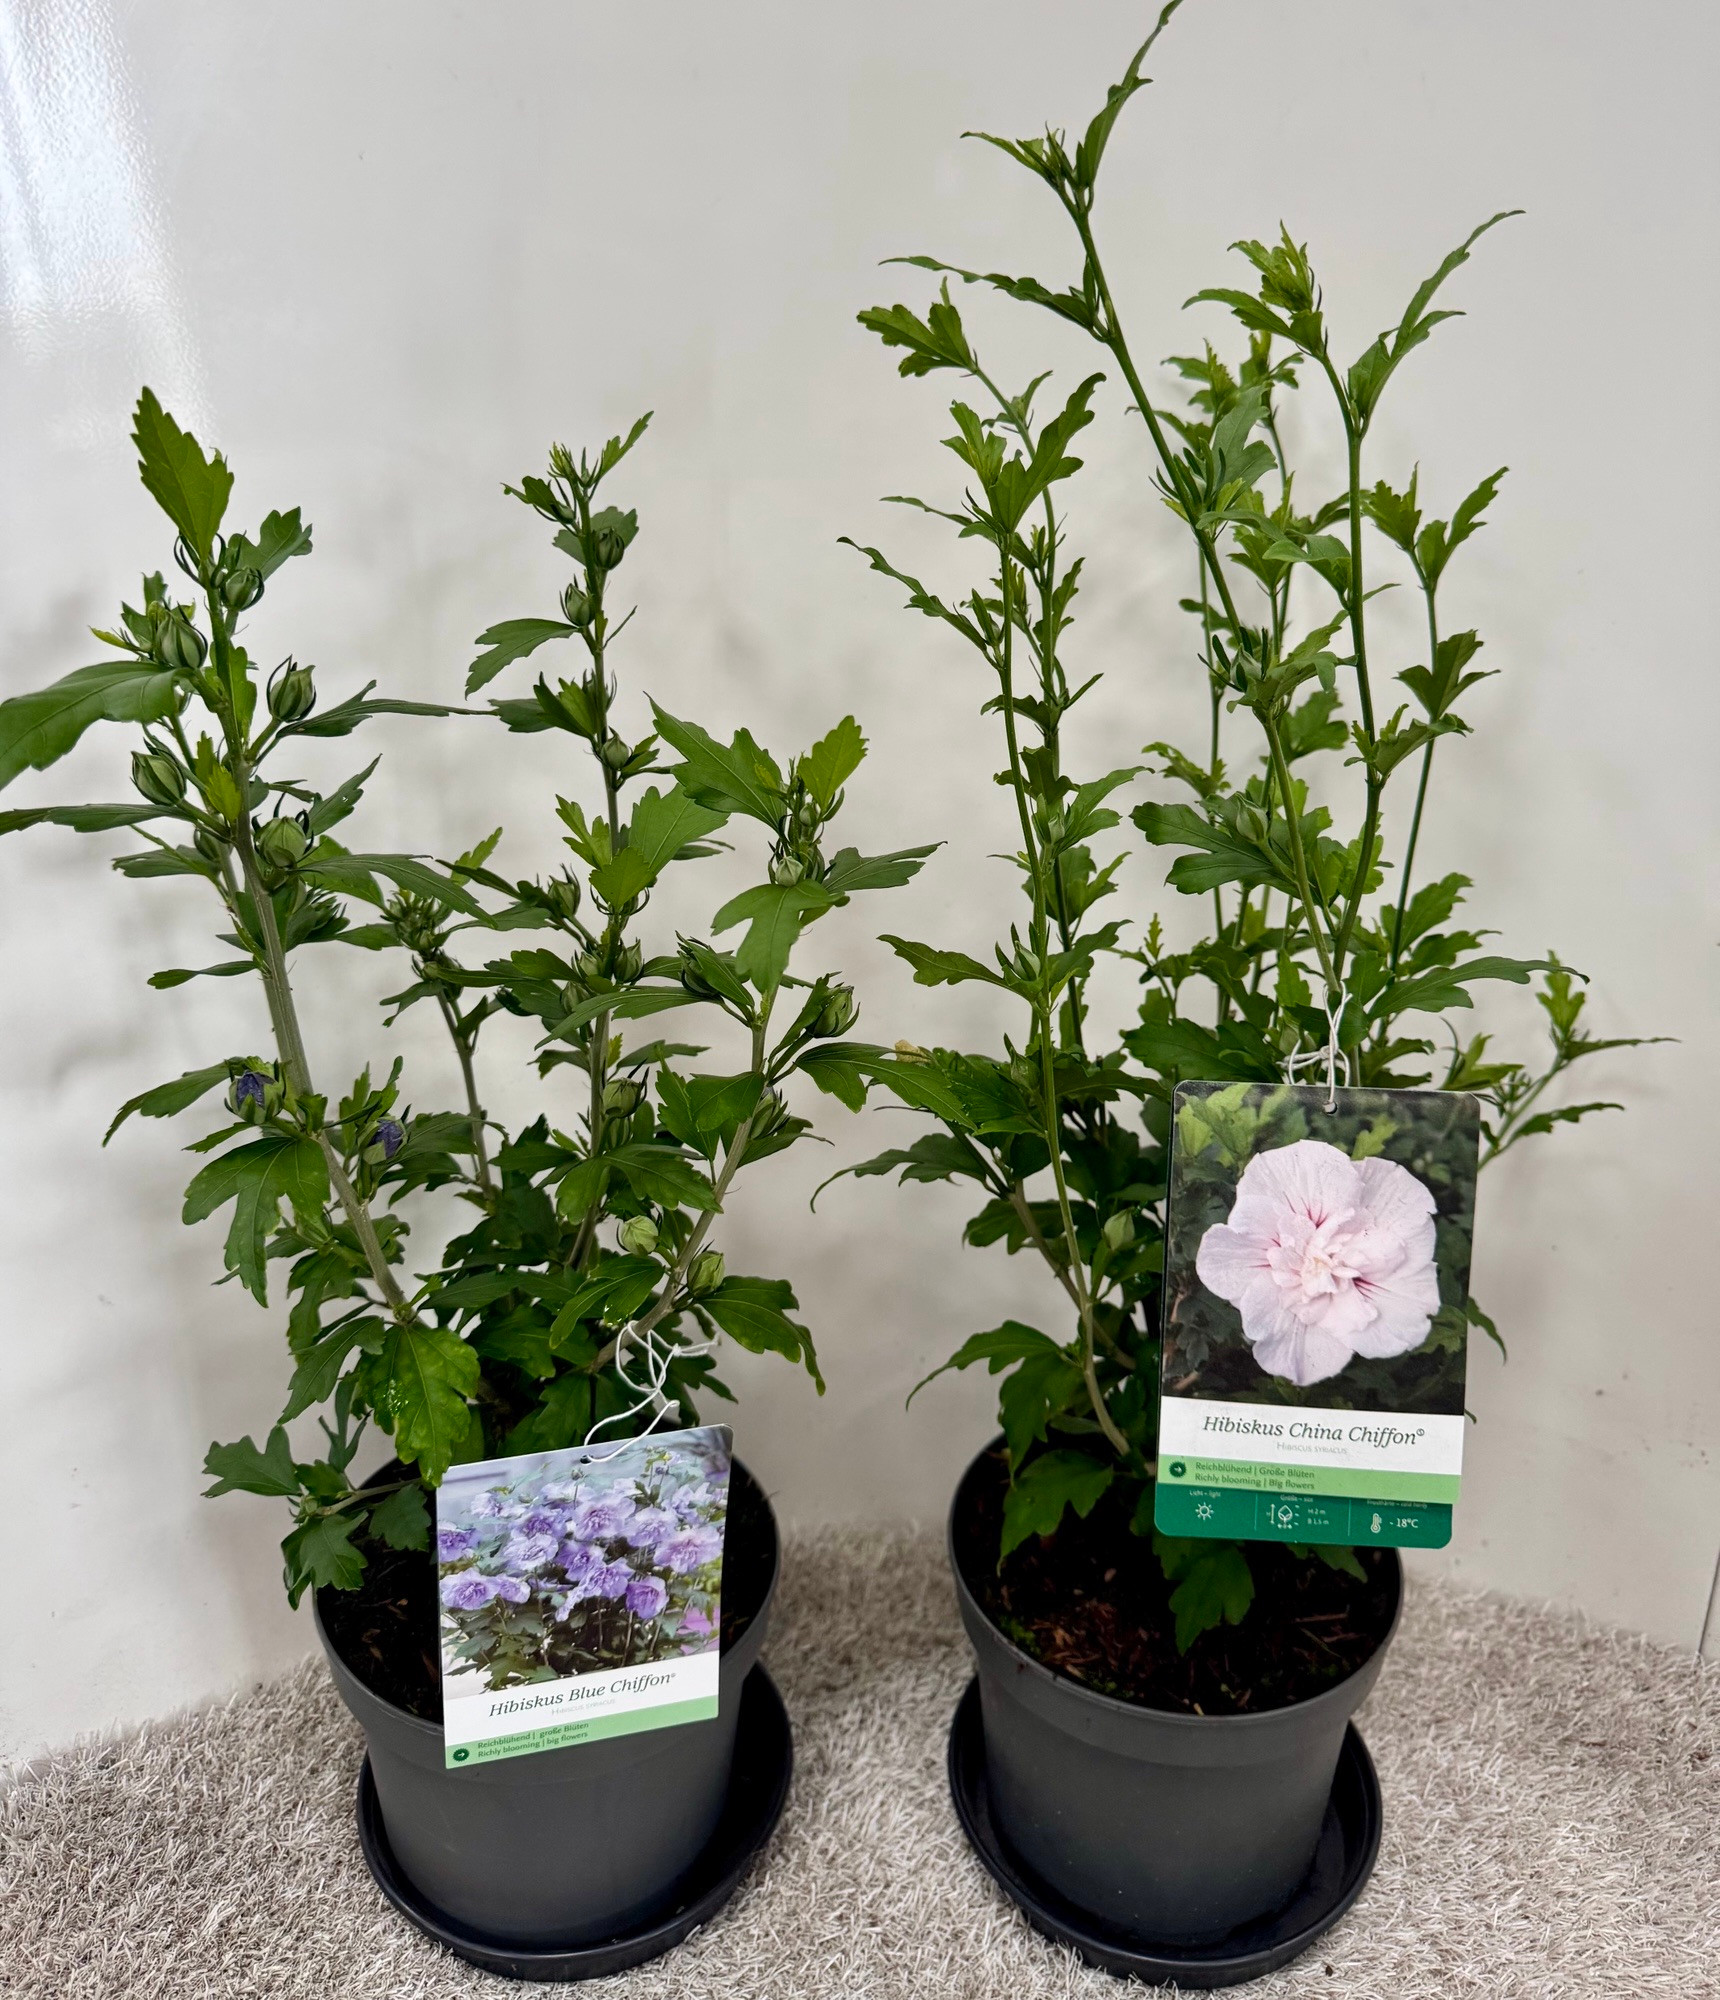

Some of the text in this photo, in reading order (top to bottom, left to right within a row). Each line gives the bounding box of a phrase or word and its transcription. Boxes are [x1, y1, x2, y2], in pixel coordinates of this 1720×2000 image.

[1203, 1416, 1284, 1437] Hibiskus
[1289, 1422, 1343, 1441] China
[1195, 1461, 1252, 1474] Reichblühend
[1259, 1466, 1285, 1477] Große
[1287, 1468, 1315, 1479] Blüten
[1195, 1473, 1219, 1484] Richly
[1221, 1474, 1261, 1487] blooming
[1269, 1478, 1283, 1489] Big
[1285, 1479, 1315, 1490] flowers
[489, 1694, 564, 1717] Hibiskus
[568, 1685, 605, 1702] Blue
[477, 1732, 531, 1749] Reichblühend
[539, 1726, 562, 1739] große
[563, 1722, 589, 1733] Blüten
[478, 1747, 501, 1758] Richly
[503, 1739, 541, 1753] blooming
[546, 1735, 560, 1745] big
[561, 1731, 588, 1742] flowers
